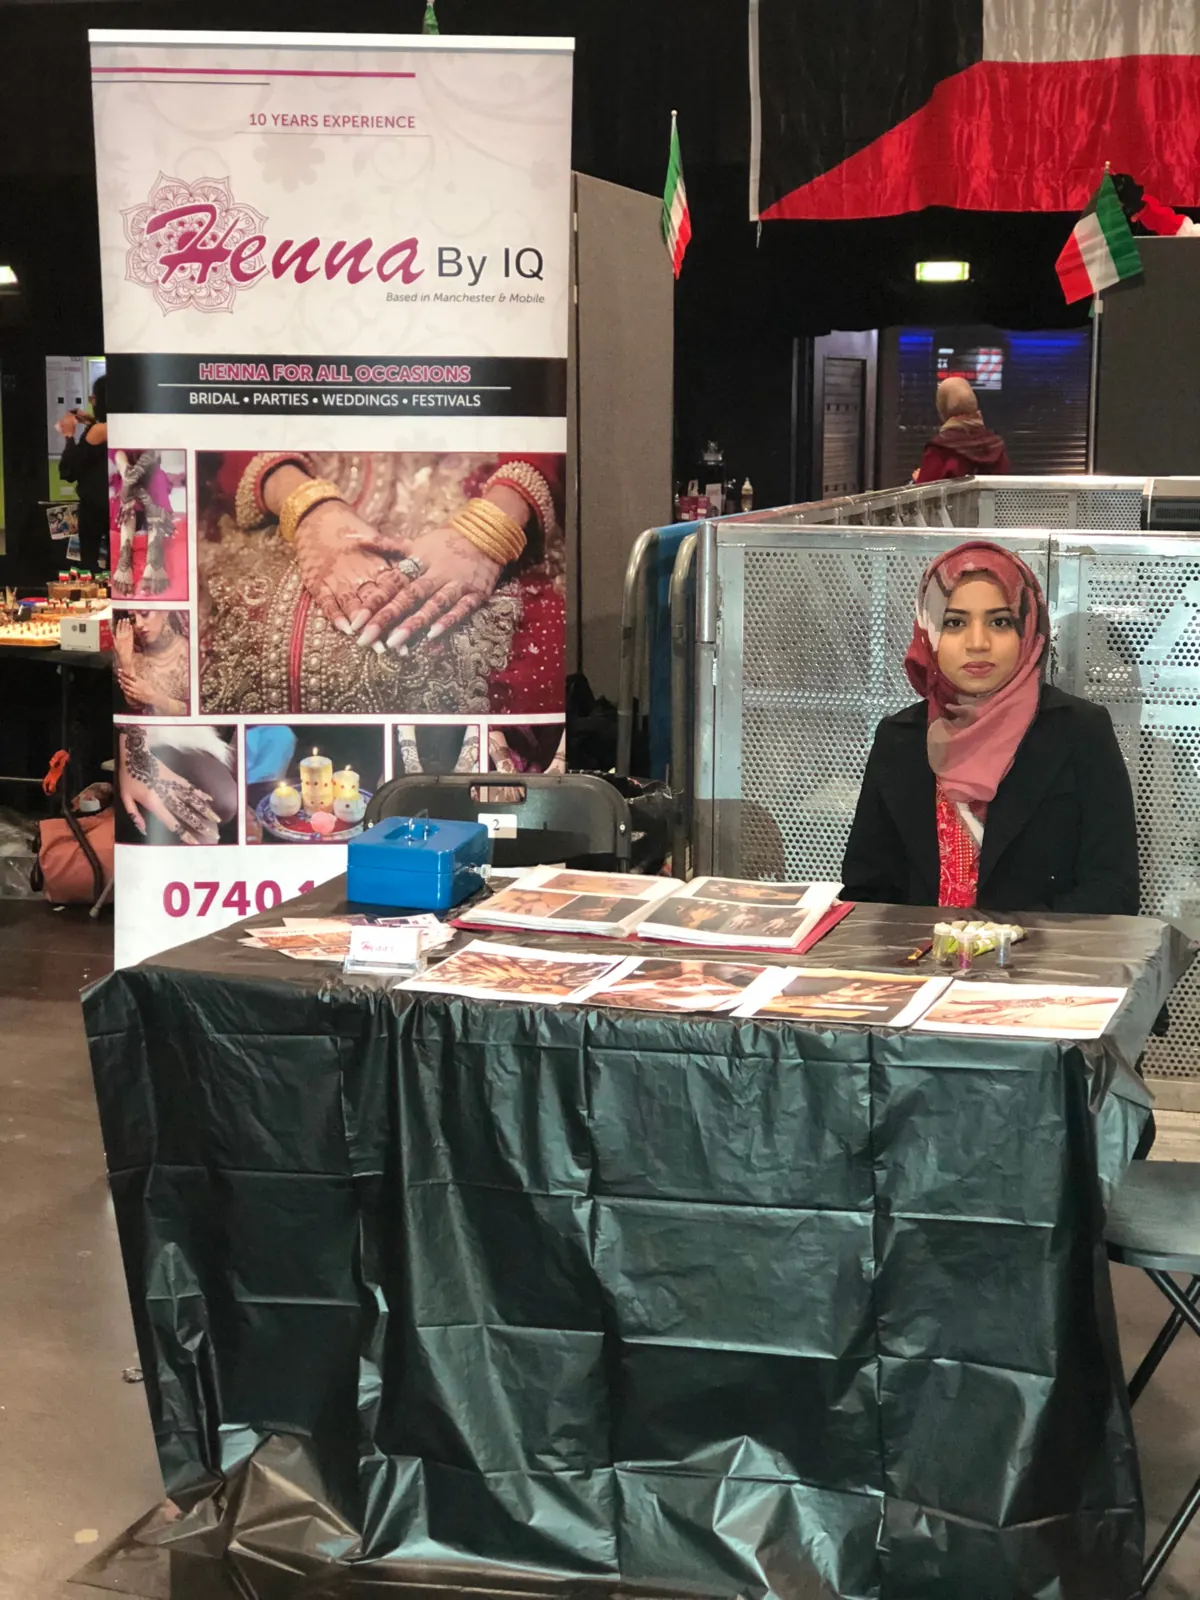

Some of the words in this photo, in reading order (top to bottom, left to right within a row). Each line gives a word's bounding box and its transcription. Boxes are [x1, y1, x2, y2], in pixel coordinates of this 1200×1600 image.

[249, 113, 267, 126] 10
[271, 113, 319, 127] YEARS
[323, 114, 416, 129] EXPERIENCE
[146, 203, 425, 285] Henna
[437, 246, 488, 286] By
[504, 247, 545, 282] IQ
[386, 292, 418, 302] Based
[420, 292, 431, 302] in
[433, 293, 495, 303] Manchester
[499, 293, 506, 303] &
[509, 293, 545, 304] Mobile
[199, 362, 270, 381] HENNA
[272, 363, 312, 382] FOR
[316, 364, 352, 382] ALL
[355, 364, 471, 383] OCCASIONS
[189, 392, 240, 405] BRIDAL
[253, 393, 309, 406] PARTIES
[322, 393, 399, 407] WEDDINGS
[412, 394, 481, 407] FESTIVALS
[492, 818, 500, 831] 2
[163, 880, 282, 917] 0740
